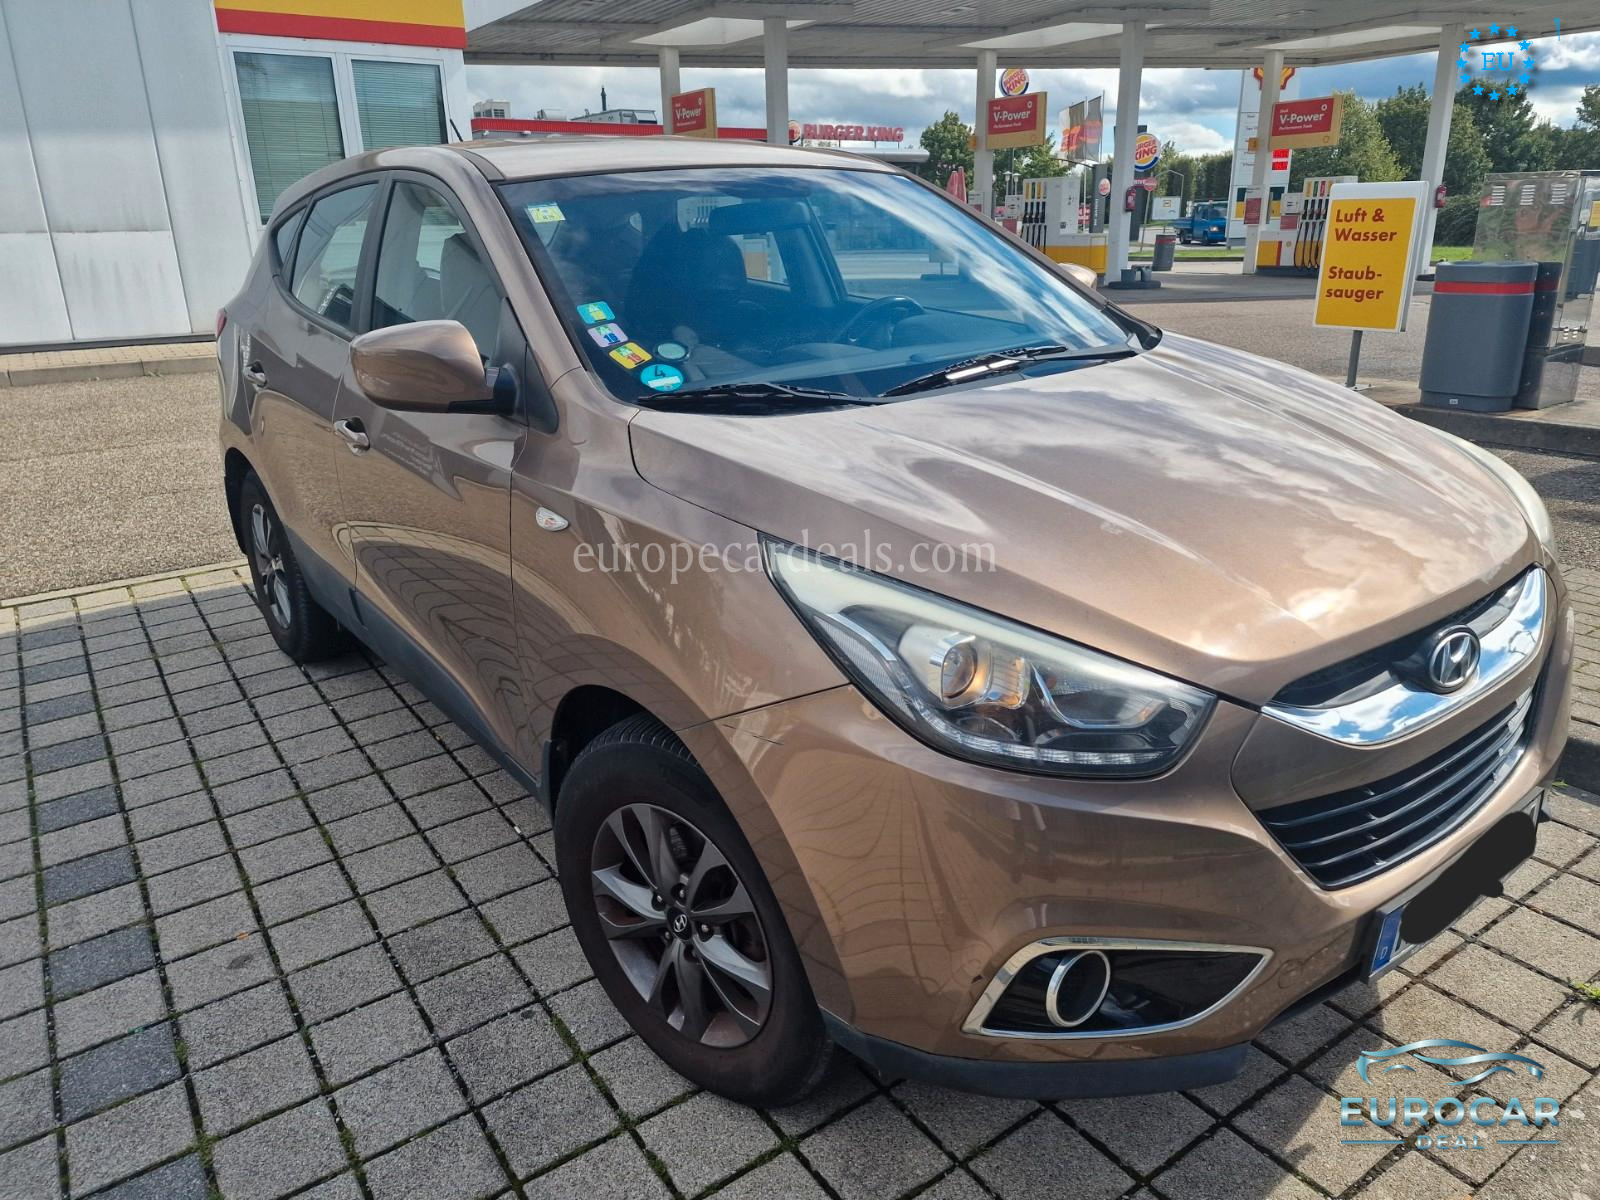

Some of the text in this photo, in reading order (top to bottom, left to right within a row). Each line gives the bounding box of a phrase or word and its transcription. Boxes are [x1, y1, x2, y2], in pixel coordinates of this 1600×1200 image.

[1006, 74, 1027, 93] KING
[675, 108, 702, 121] V-Power
[993, 110, 1031, 122] V-Power
[1279, 113, 1325, 124] V-Power
[803, 123, 864, 140] BURGER
[867, 126, 904, 142] KING
[1336, 208, 1385, 223] Luft &
[1335, 228, 1397, 242] Wasser
[1328, 266, 1382, 280] Staub-
[1326, 288, 1384, 303] sauger
[654, 365, 666, 378] 4
